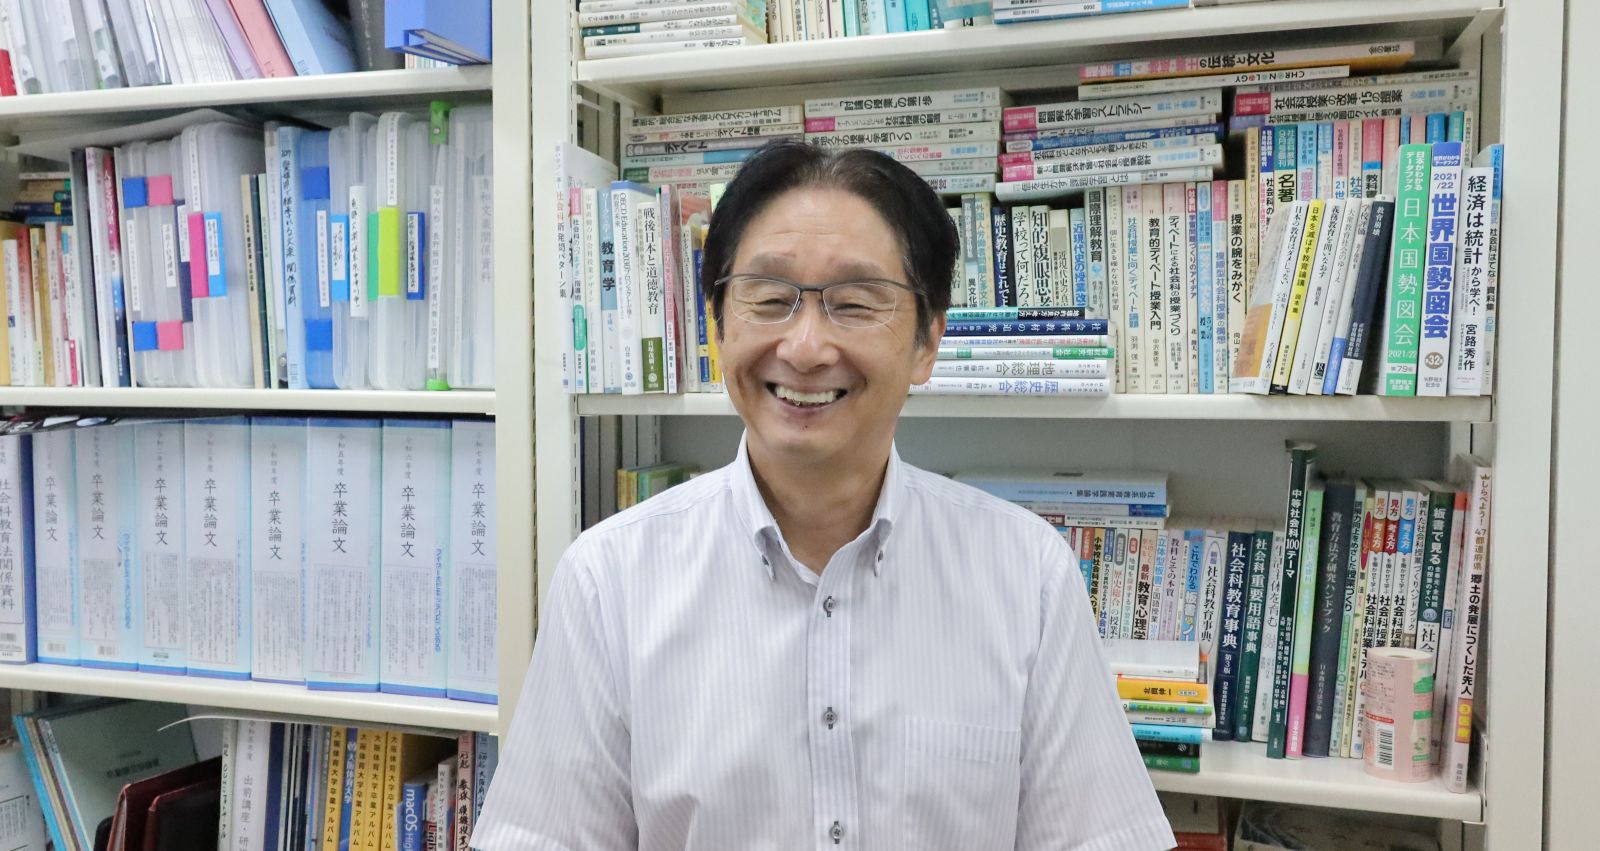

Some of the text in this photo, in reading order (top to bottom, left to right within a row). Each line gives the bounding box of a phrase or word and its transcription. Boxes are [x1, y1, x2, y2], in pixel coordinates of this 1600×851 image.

[839, 95, 933, 111] 「討論の授業」の第一歩
[1037, 102, 1152, 125] 問題解決学習のストラテジー
[1277, 173, 1295, 203] 名著
[1404, 151, 1415, 192] データブック
[1413, 151, 1425, 191] 日本がわかる
[1433, 173, 1456, 181] 2021
[1436, 182, 1454, 191] /22
[1088, 190, 1103, 263] 国際理解教育
[1230, 213, 1243, 303] 授業の腕をみがく
[1296, 206, 1320, 288] 日本を滅ぼす教育論議
[1318, 205, 1340, 280] 義務教育を問いなおす
[1334, 208, 1354, 284] 大衆教育社会のゆくえ
[602, 241, 616, 292] 教育学
[643, 207, 658, 315] 戦後日本と道徳教育
[1148, 217, 1162, 330] 教育的ディベート授業入門
[1168, 216, 1181, 336] ディベートによる社会科の授業づくり
[1393, 197, 1420, 347] 日本国勢図会
[1423, 193, 1457, 340] 世界国勢図会
[988, 322, 1101, 332] 社会科教材の追究
[1463, 322, 1478, 371] 宮路秀作
[995, 361, 1056, 376] 地理総合
[998, 379, 1059, 394] 歴史総合
[44, 475, 58, 542] 卒業論文
[91, 473, 105, 540] 卒業論文
[154, 477, 169, 545] 卒業論文
[203, 478, 218, 548] 卒業論文
[267, 489, 283, 560] 卒業論文
[331, 482, 348, 554] 卒業論文
[400, 485, 416, 558] 卒業論文
[471, 482, 486, 557] 卒業論文
[1285, 489, 1302, 578] 中等社会科100テーマ
[1372, 523, 1384, 549] 考え方
[1376, 498, 1386, 516] 見方
[1385, 524, 1398, 550] 考え方
[1390, 499, 1400, 516] 見方
[1401, 523, 1414, 549] 考え方
[1404, 497, 1415, 516] 見方
[1429, 507, 1447, 564] 板書で見る
[1188, 545, 1200, 590] これでわかる
[1223, 542, 1246, 647] 社会科教育事典
[1244, 538, 1268, 655] 社会科重要用語事典
[1321, 512, 1343, 633] 教育方法学研究ハンドブック
[1407, 500, 1428, 631] 優れた社会科授業づくりハンドブック
[1424, 565, 1434, 607] の授業のすべて
[1133, 581, 1151, 640] 教育心理学
[1200, 565, 1218, 642] 社会科教育事典
[1460, 574, 1482, 696] 郷土の発展につくした先人
[1223, 653, 1232, 674] 第3版
[1421, 628, 1436, 653] 社会
[238, 775, 253, 851] 出前講座・研
[327, 731, 342, 842] 大阪体育大学卒業アルバム
[353, 733, 367, 846] 大阪体育大学卒業アルバム
[368, 735, 381, 847] 大阪体育大学卒業アルバム
[385, 736, 398, 848] 大阪体育大学卒業アルバム
[405, 789, 418, 831] macOS
